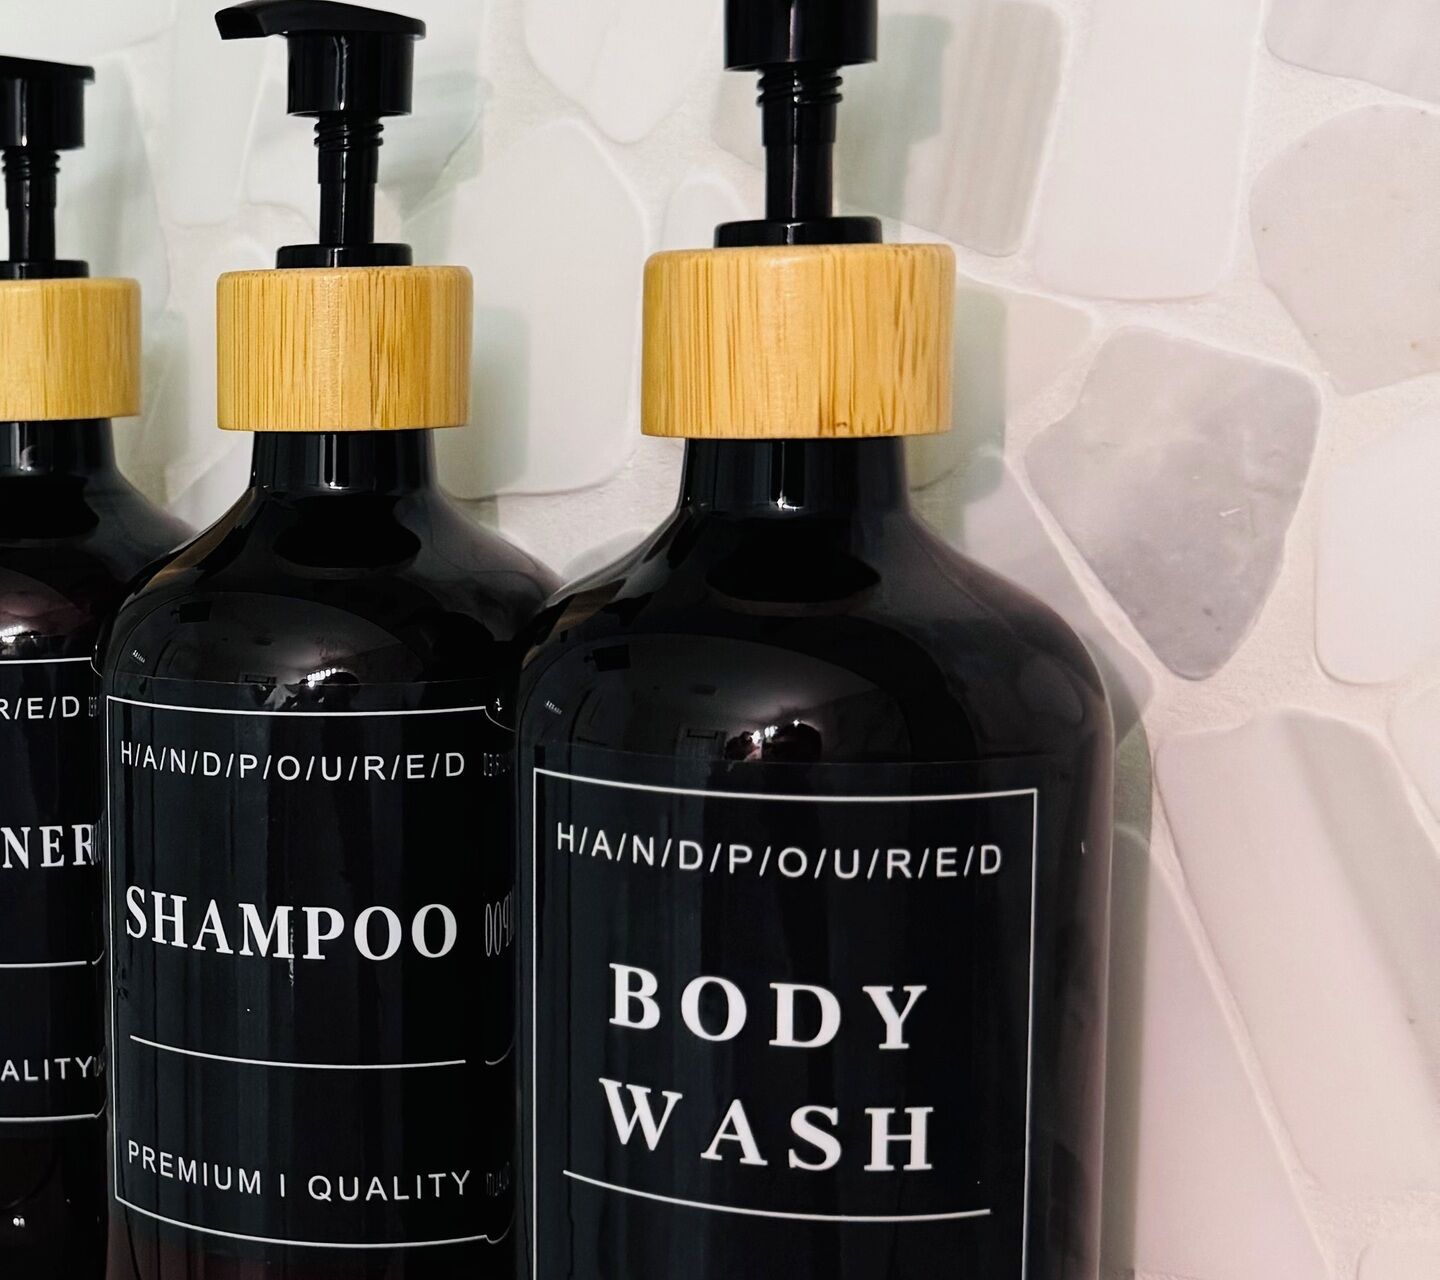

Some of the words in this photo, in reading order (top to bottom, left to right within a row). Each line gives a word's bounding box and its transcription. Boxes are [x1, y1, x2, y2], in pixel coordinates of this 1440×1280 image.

[120, 739, 466, 782] H/A/N/D/P/O/U/R/E/D
[556, 821, 1003, 880] H/A/N/D/P/O/U/R/E/D
[125, 885, 458, 961] SHAMPOO
[608, 962, 928, 1050] BODY
[597, 1076, 934, 1172] WASH
[127, 1138, 262, 1196] PREMIUM
[306, 1168, 471, 1202] QUALITY
